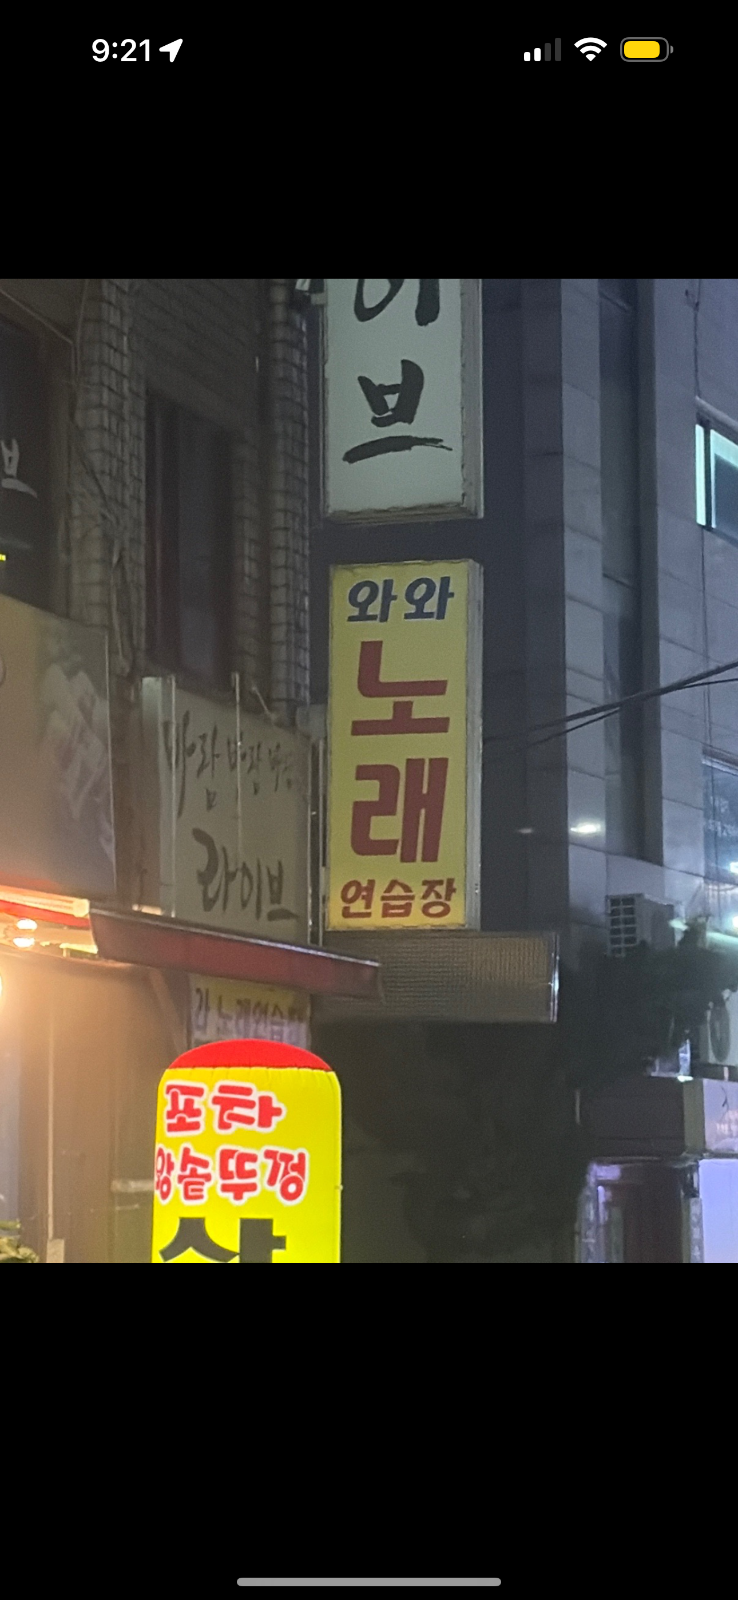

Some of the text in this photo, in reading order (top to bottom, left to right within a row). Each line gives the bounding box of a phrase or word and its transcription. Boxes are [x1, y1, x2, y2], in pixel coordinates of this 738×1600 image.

[347, 576, 455, 623] 와와
[351, 640, 450, 863] 노래
[192, 827, 300, 922] 라이브
[340, 877, 456, 920] 연습장
[165, 1083, 283, 1133] 포차
[155, 1146, 306, 1202] 왕솥뚜껑
